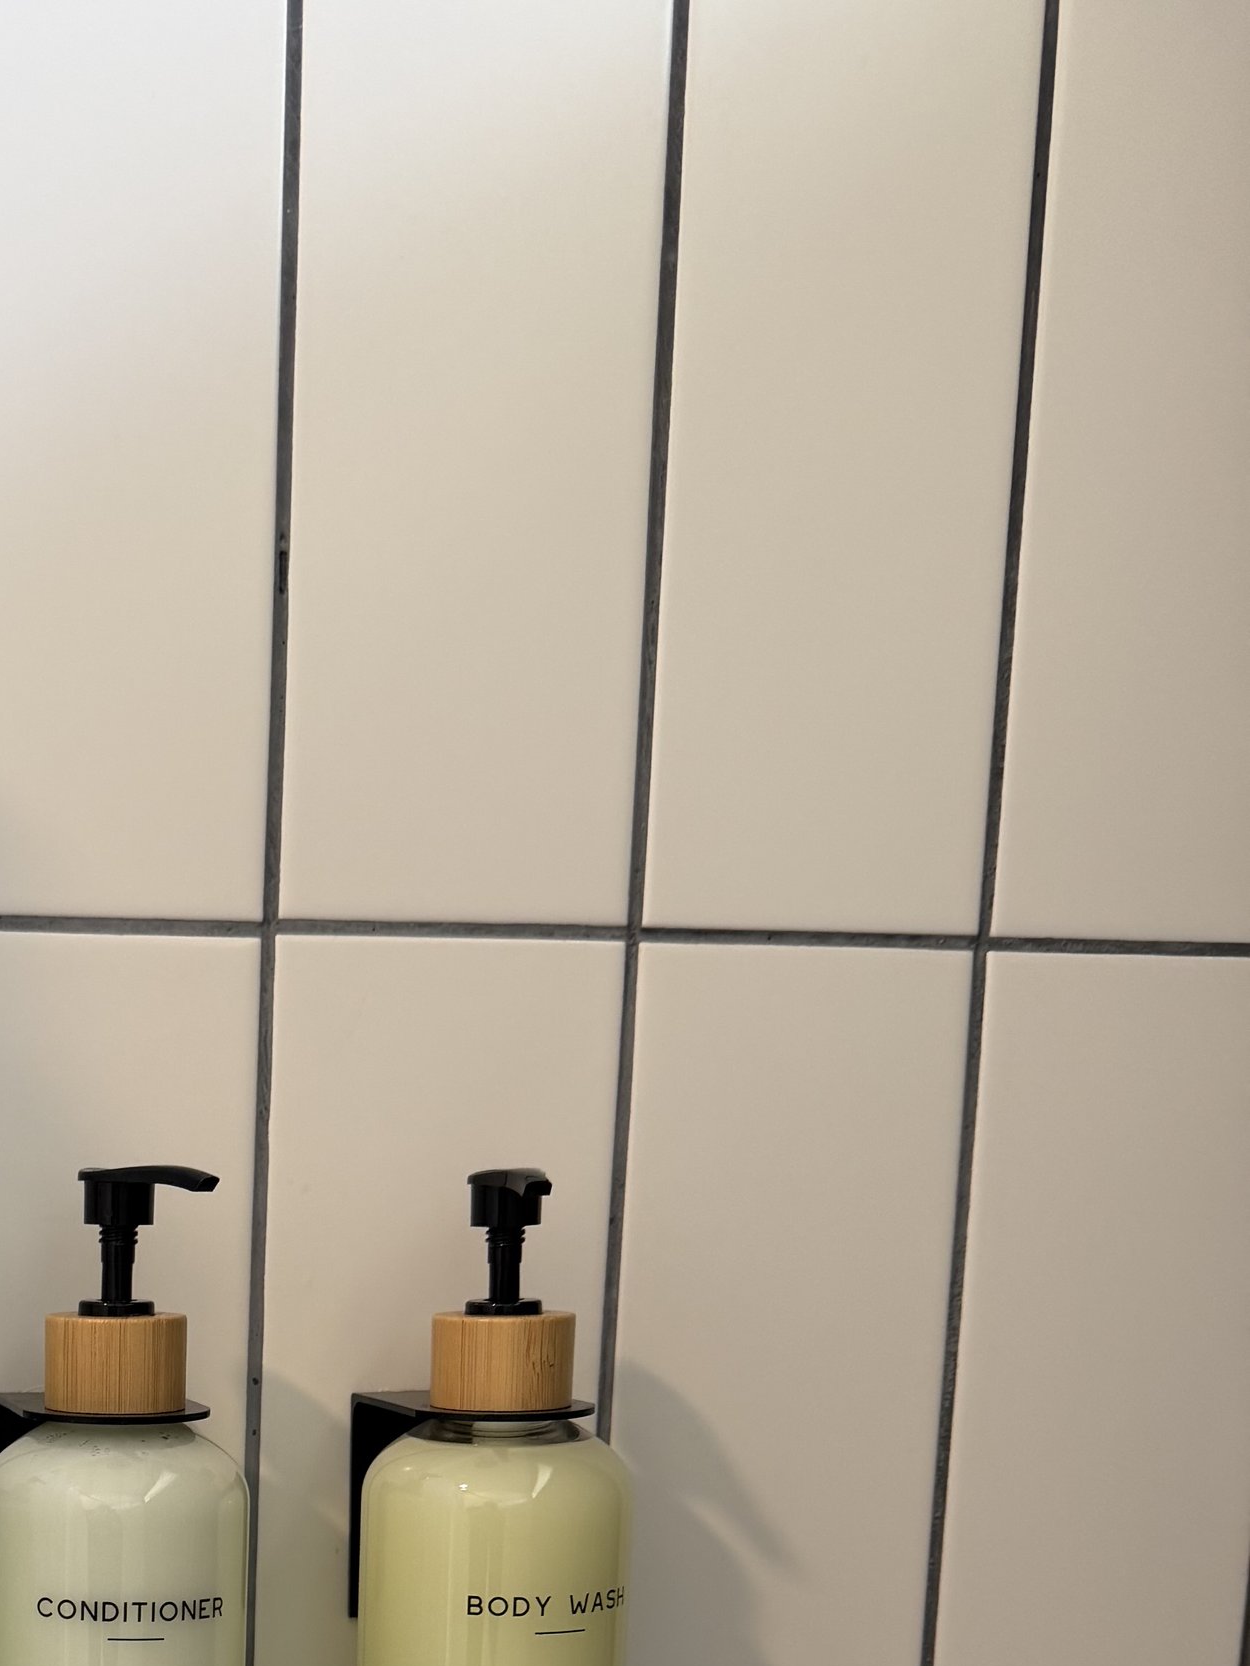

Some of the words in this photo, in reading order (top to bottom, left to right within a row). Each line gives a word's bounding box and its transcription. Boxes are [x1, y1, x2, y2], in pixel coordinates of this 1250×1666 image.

[36, 1596, 224, 1623] CONDITIONER
[466, 1594, 552, 1618] BODY
[569, 1586, 626, 1615] WASH
